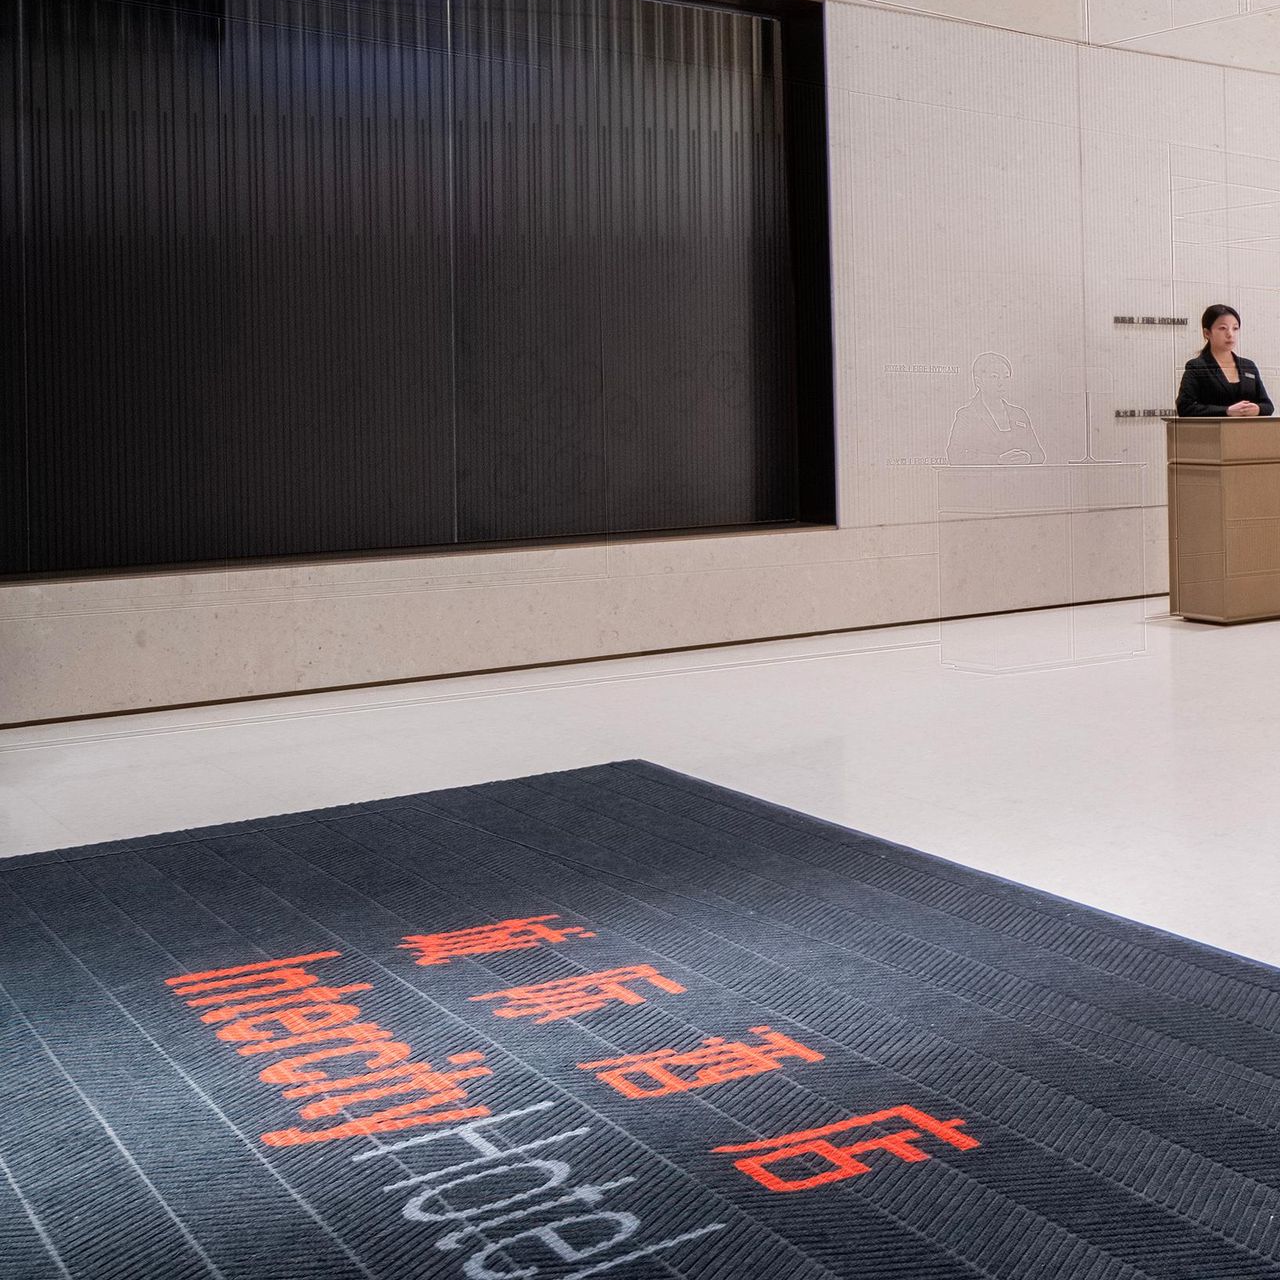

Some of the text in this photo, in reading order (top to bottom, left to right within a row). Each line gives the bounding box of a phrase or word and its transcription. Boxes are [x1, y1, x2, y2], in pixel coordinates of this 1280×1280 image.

[1142, 316, 1157, 325] FIRE
[1158, 317, 1188, 326] HYDRANT
[1143, 409, 1158, 417] FIRE
[397, 913, 981, 1192] 城际酒店
